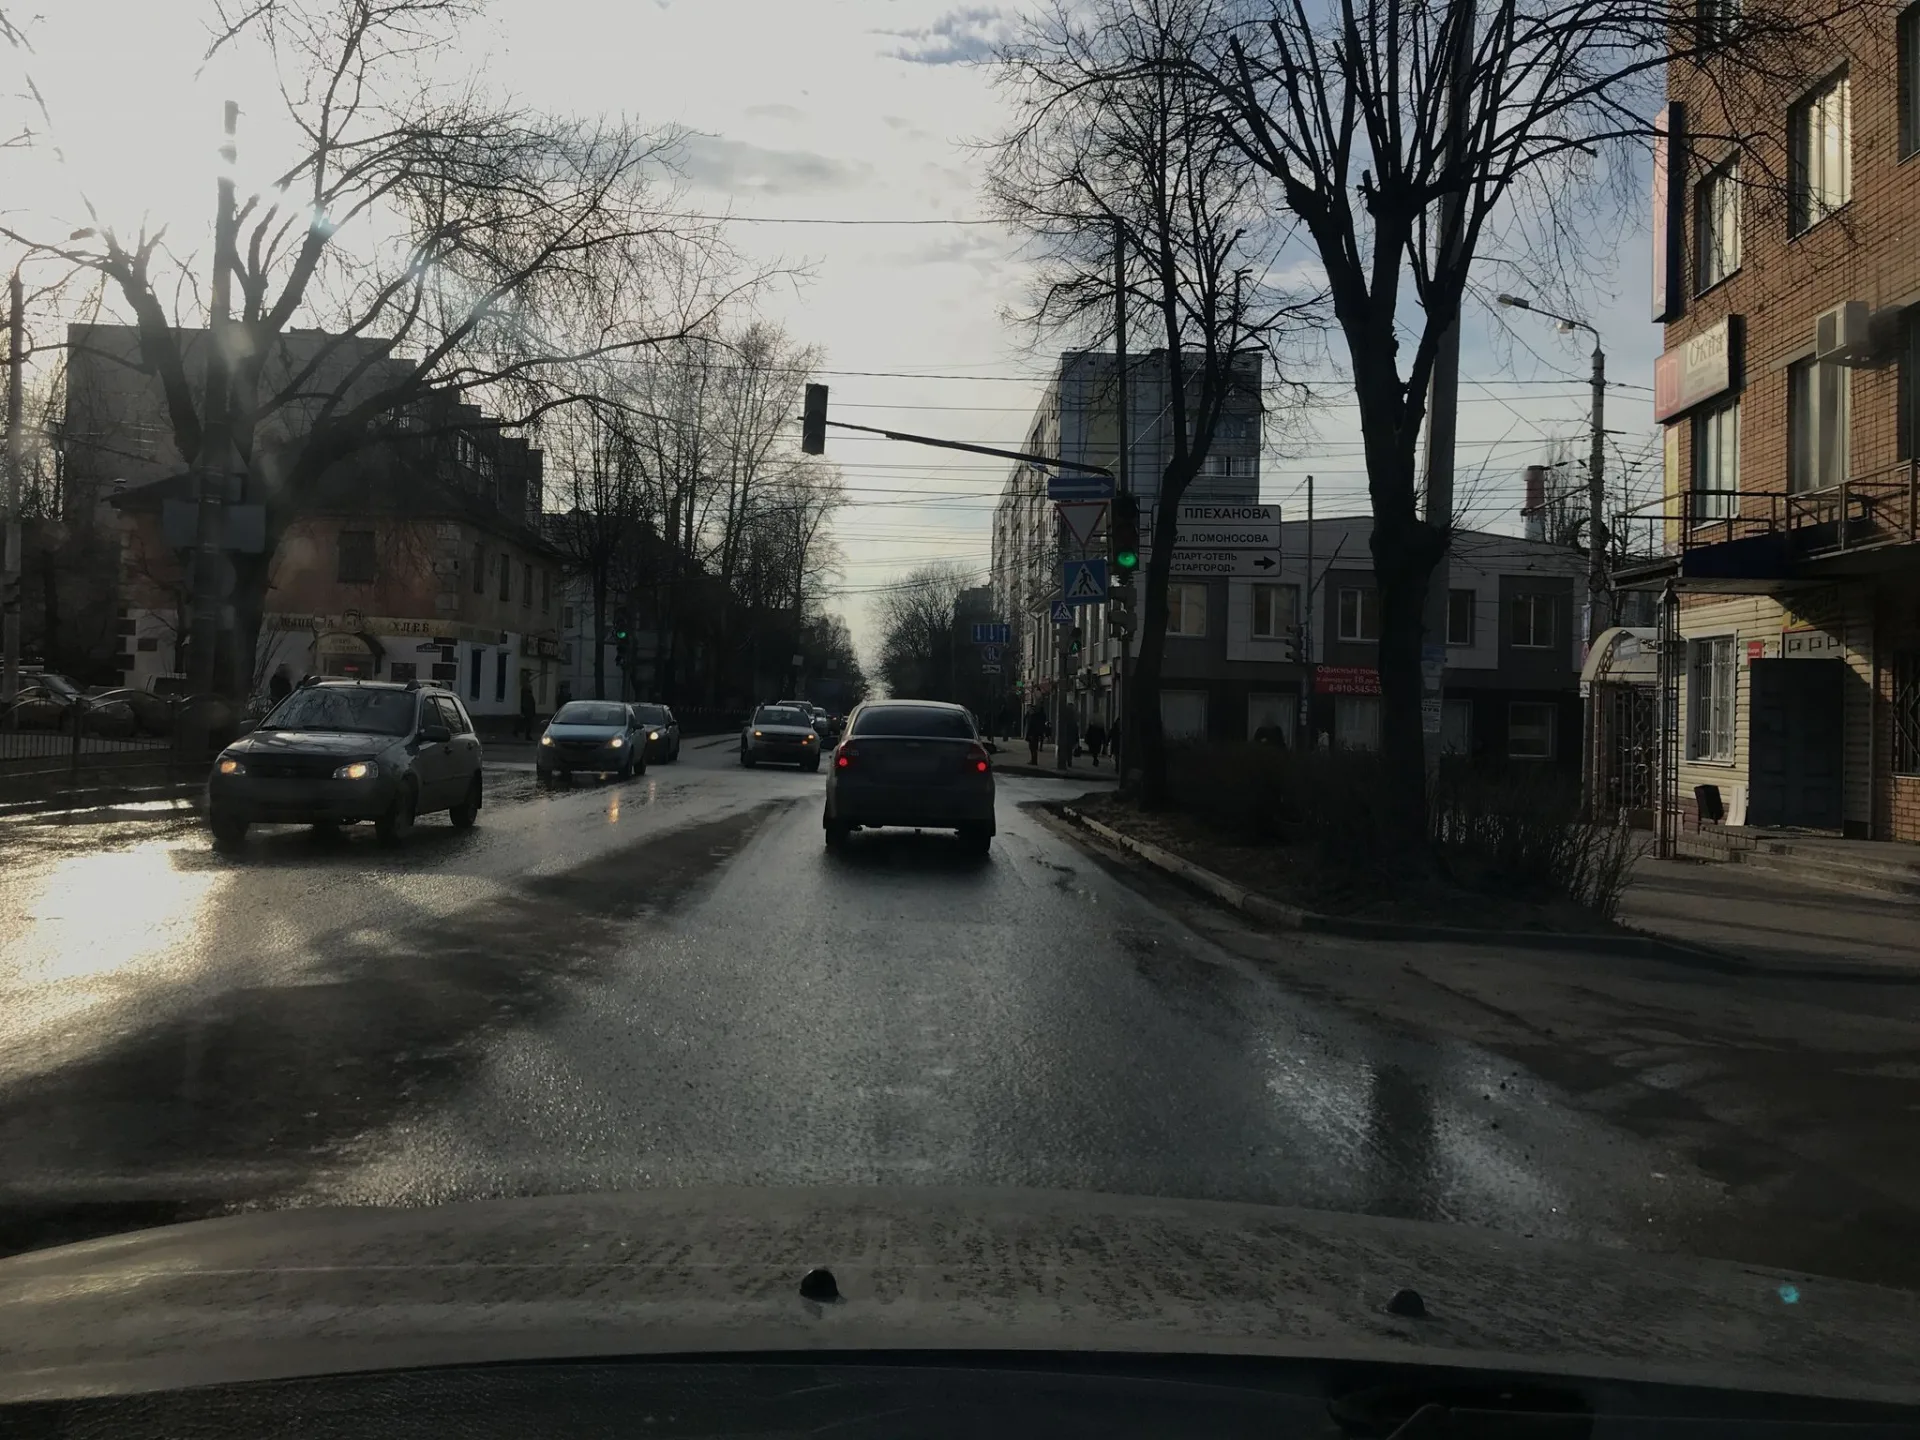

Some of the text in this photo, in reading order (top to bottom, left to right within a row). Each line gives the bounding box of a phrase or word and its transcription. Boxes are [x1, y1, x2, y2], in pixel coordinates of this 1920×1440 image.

[1690, 335, 1722, 367] Окна
[1185, 508, 1271, 519] ПЛЕХАНОВА
[1191, 534, 1269, 543] ЛОМОНОСОВА
[1172, 553, 1237, 561] АПАРТ-ОТЕЛЬ
[393, 621, 429, 632] ХЛЕБ
